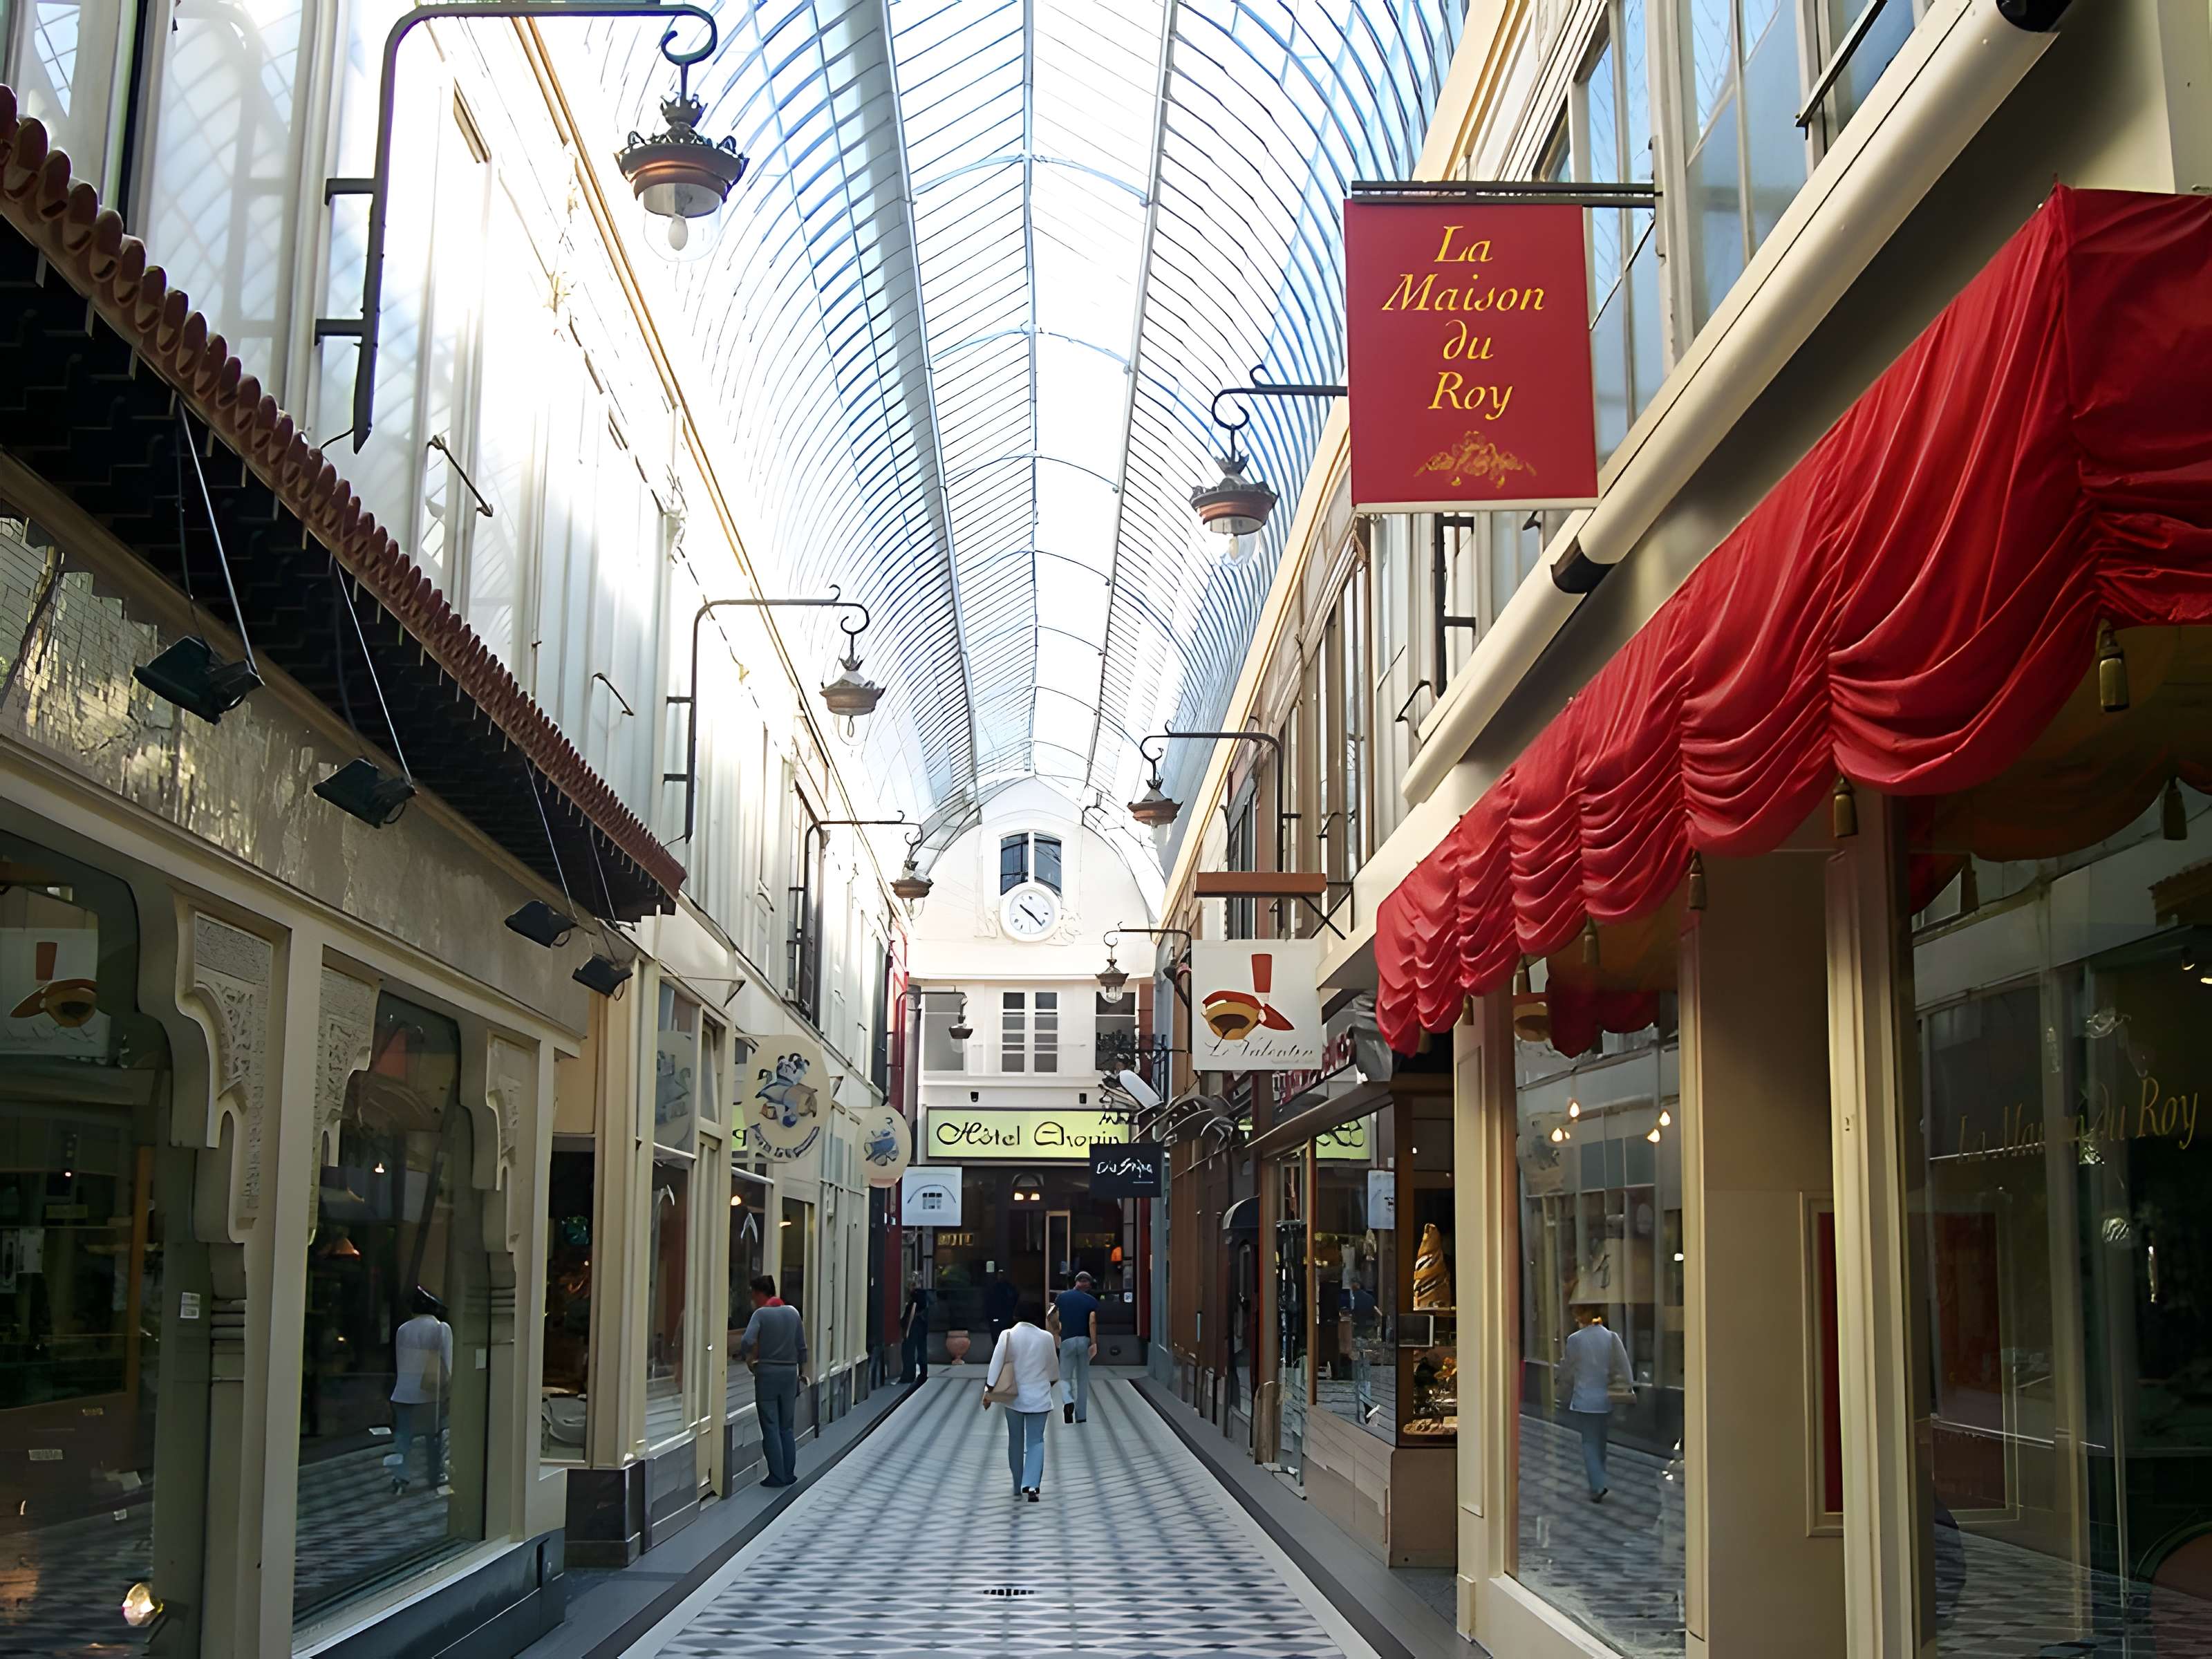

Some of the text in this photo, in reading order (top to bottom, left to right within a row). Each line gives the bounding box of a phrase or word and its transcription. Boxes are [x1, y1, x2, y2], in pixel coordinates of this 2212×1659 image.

[1434, 225, 1493, 263] La
[1381, 273, 1546, 311] Maison
[1442, 319, 1494, 360] du
[1427, 371, 1514, 420] Roy
[2136, 1076, 2199, 1150] Roy
